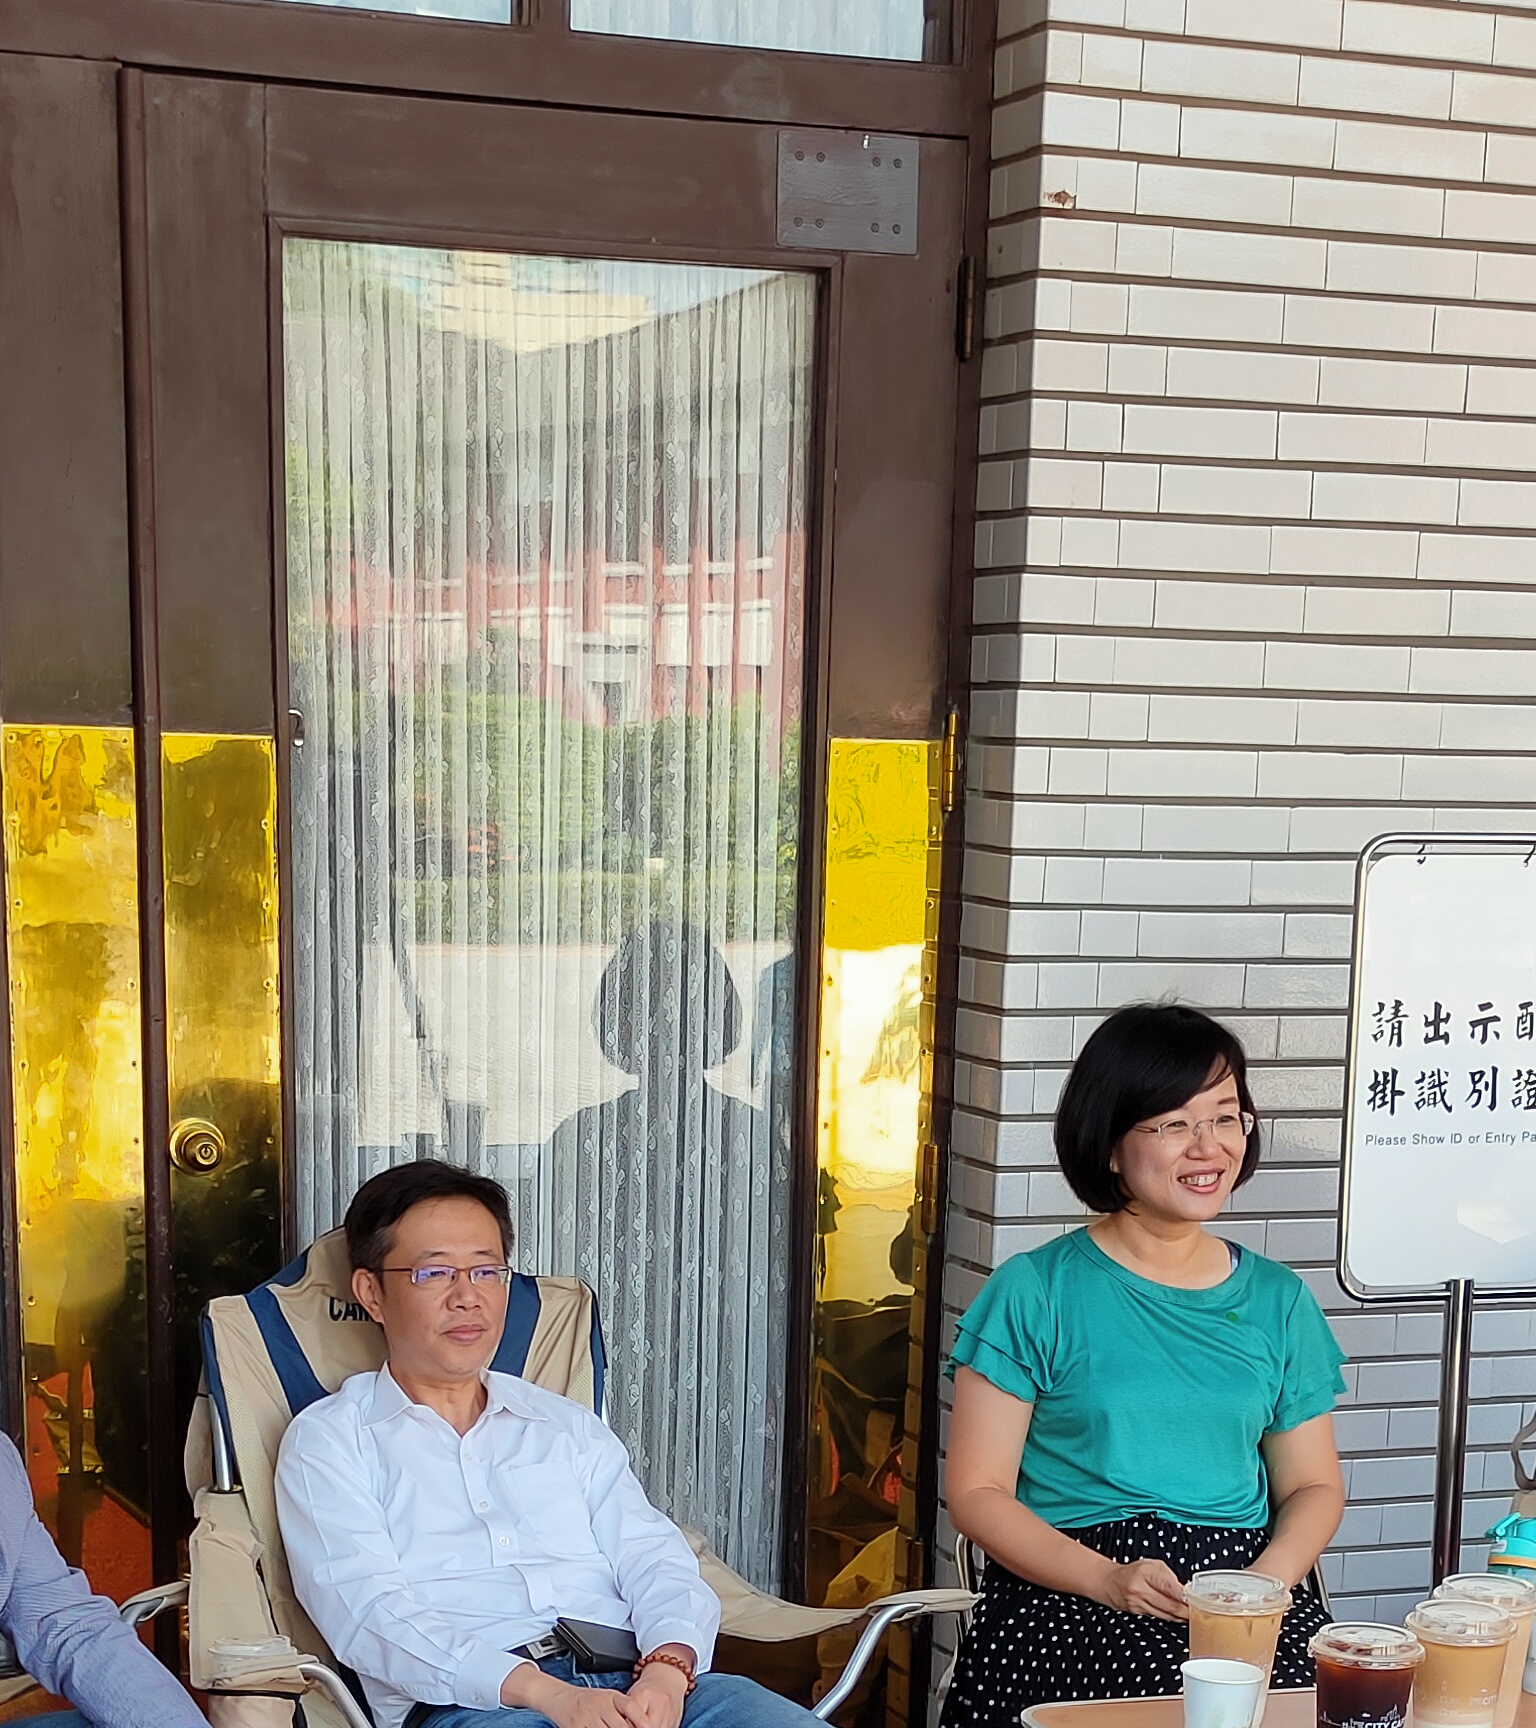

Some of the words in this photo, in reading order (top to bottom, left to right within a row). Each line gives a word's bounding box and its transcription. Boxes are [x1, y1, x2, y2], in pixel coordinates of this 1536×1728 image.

[1365, 1134, 1407, 1146] Please
[1412, 1133, 1445, 1145] Show
[1450, 1133, 1463, 1144] ID
[1468, 1134, 1480, 1144] or
[1485, 1131, 1517, 1146] Entry
